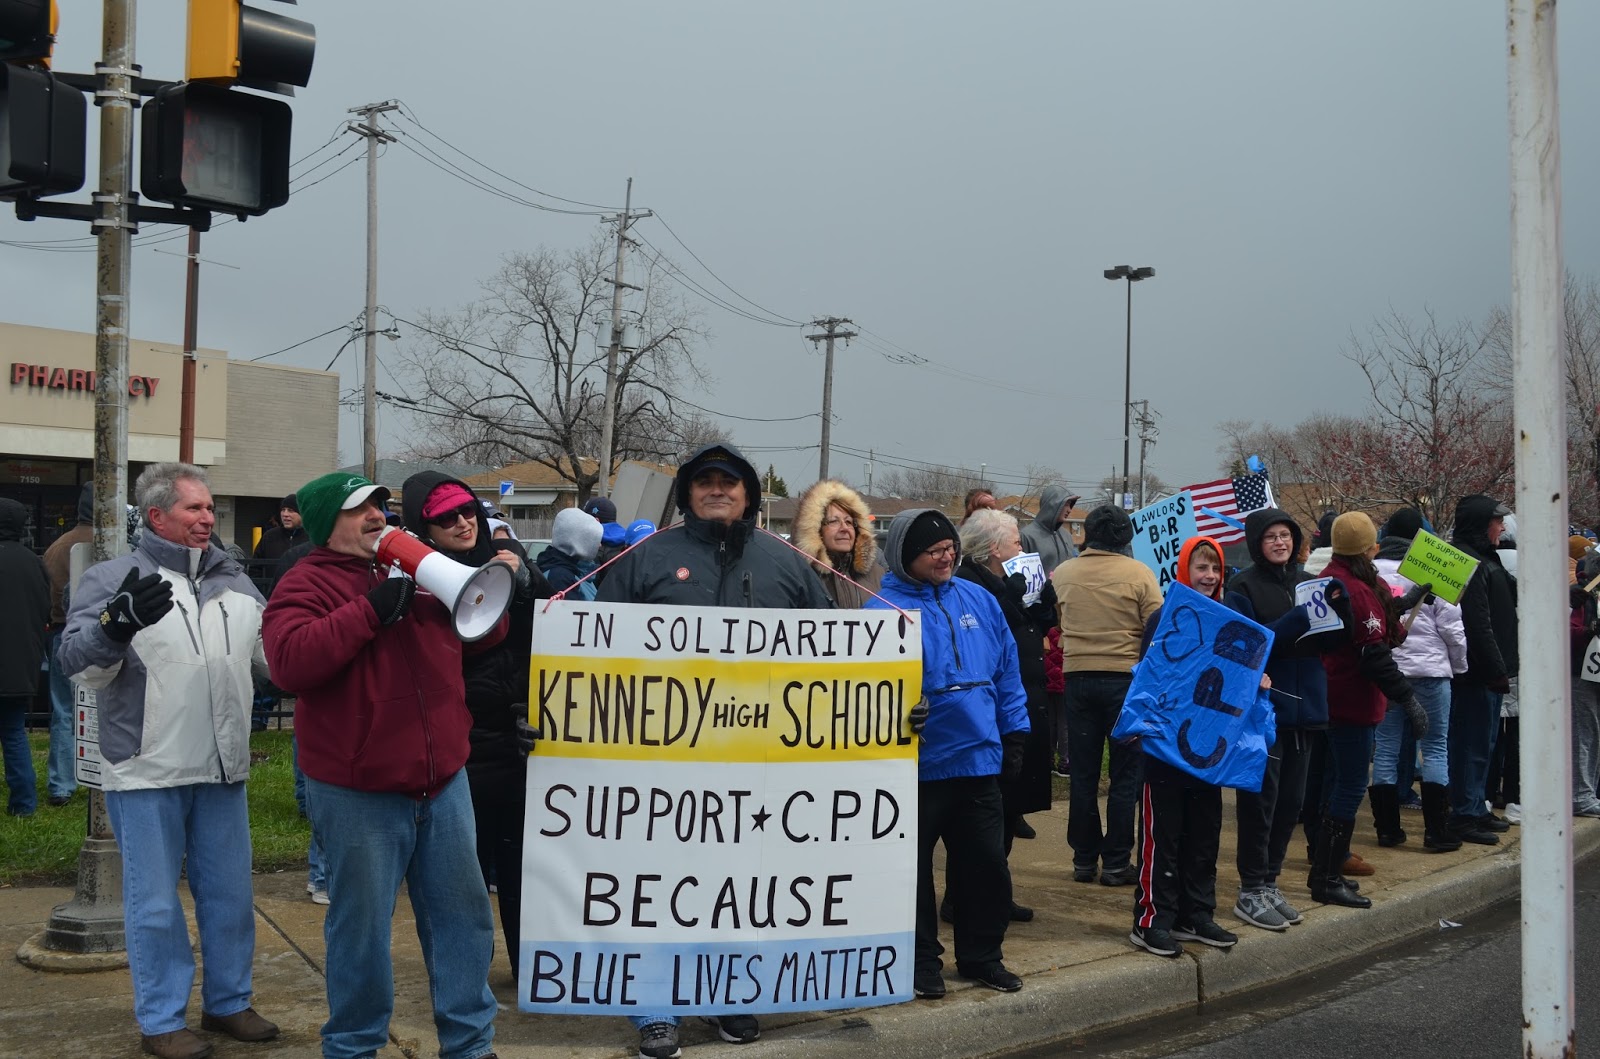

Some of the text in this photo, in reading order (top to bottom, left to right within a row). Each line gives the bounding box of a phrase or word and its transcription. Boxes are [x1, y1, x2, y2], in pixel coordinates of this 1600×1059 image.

[11, 363, 160, 397] PHARCY
[20, 475, 40, 484] 7150
[1131, 496, 1186, 535] LAWLORS
[1148, 516, 1179, 545] BAR
[1153, 537, 1180, 565] WE
[1406, 555, 1437, 576] DISTRICT
[1424, 536, 1470, 565] WE SUPPORT
[1425, 552, 1442, 565] OUR
[570, 611, 615, 649] IN
[538, 669, 716, 748] KENNEDY
[779, 678, 912, 750] SCHOOL
[539, 783, 906, 844] SUPPORT C.P.D.
[582, 872, 853, 929] BECAUSE
[529, 945, 898, 1007] BLUE LIVES MATTER
